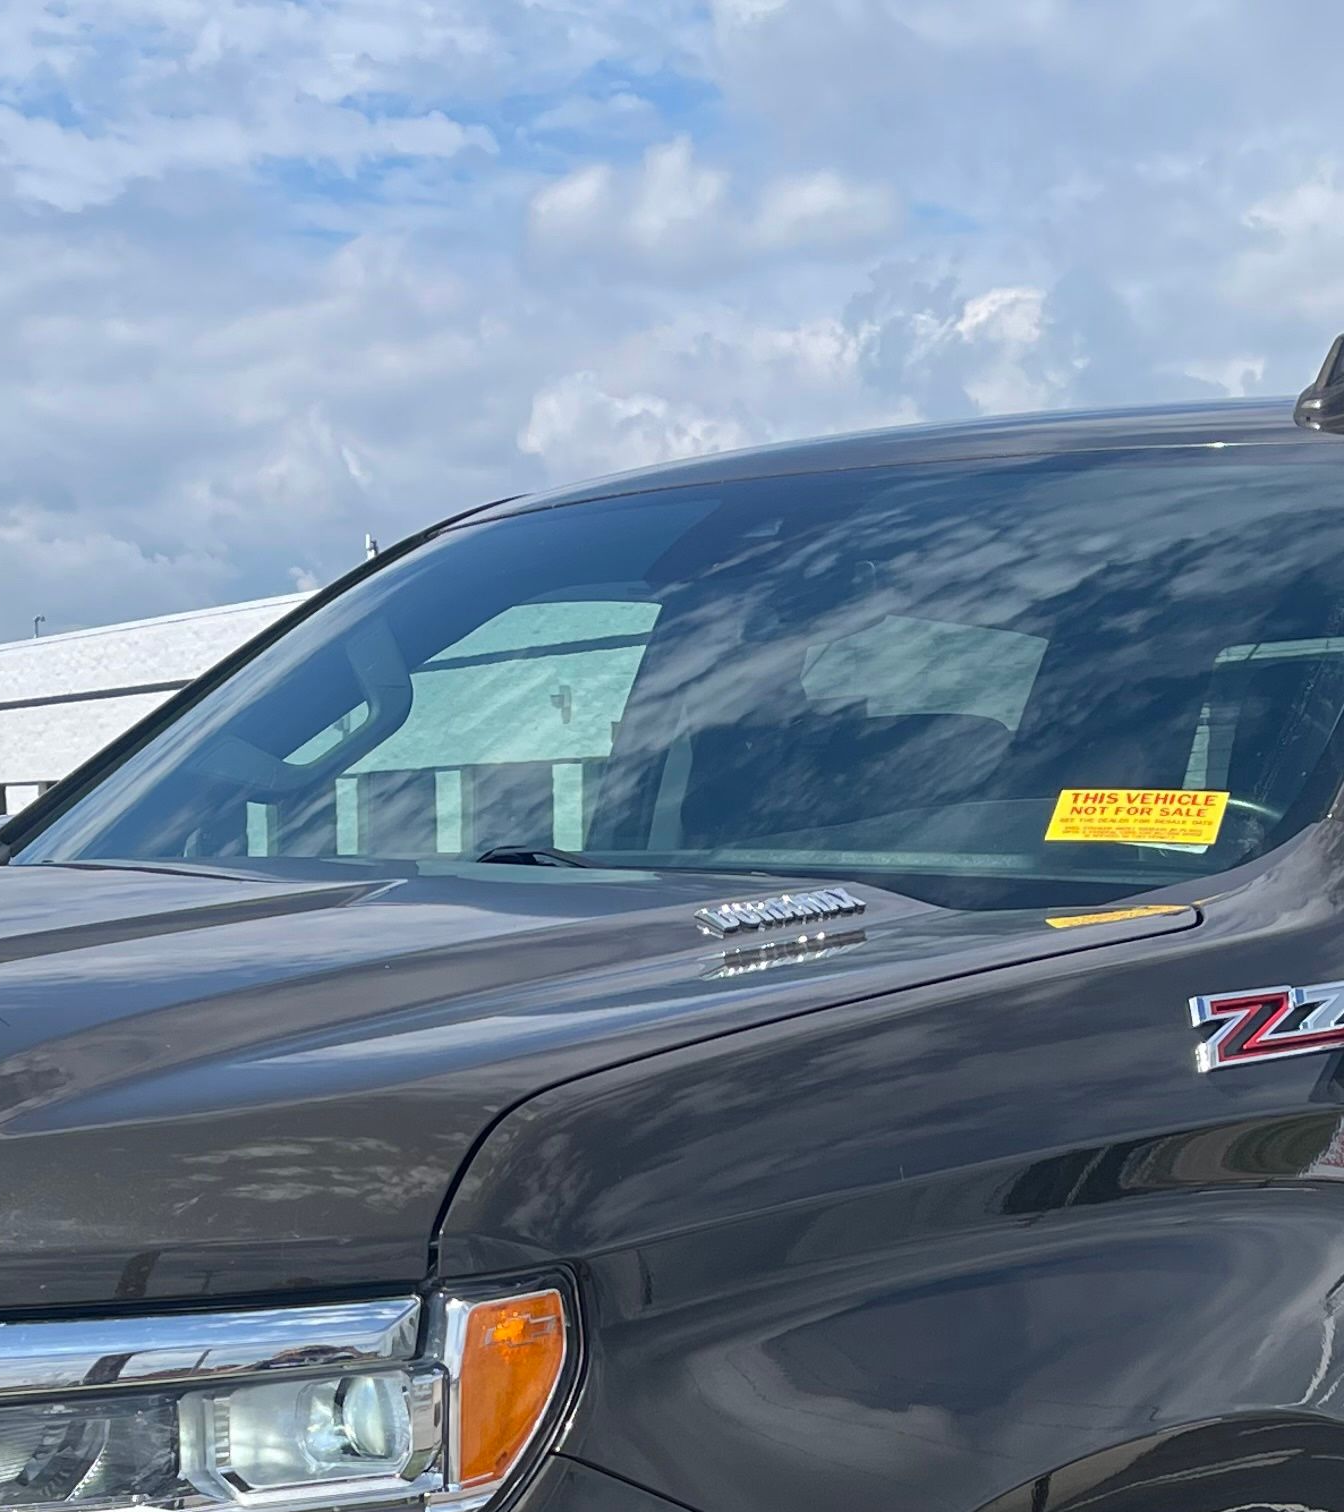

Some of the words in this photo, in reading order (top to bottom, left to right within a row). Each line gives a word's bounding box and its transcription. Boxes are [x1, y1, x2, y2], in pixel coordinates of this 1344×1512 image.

[1071, 792, 1119, 805] THIS
[1126, 793, 1218, 807] VEHICLE
[1069, 806, 1106, 816] NOT
[1114, 806, 1153, 817] FOR
[1159, 807, 1208, 817] SALE
